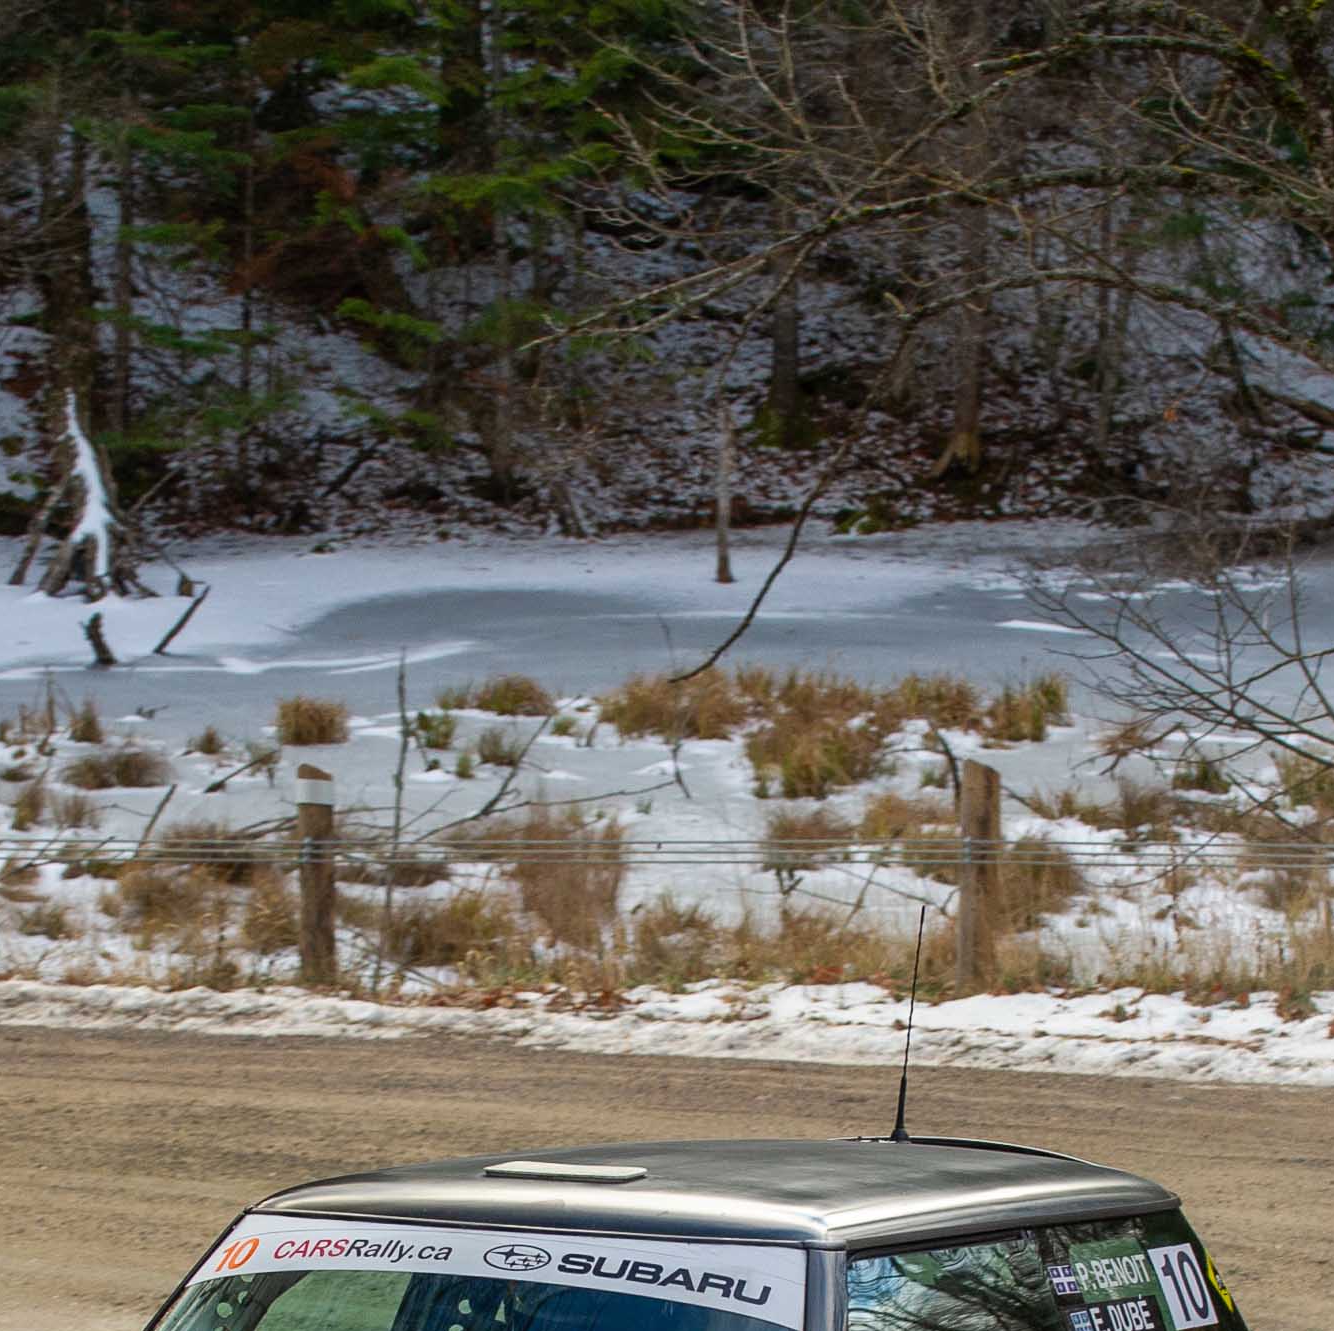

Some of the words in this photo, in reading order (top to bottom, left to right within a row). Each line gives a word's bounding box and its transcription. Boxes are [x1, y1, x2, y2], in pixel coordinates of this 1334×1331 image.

[215, 1238, 259, 1272] 10
[274, 1239, 453, 1263] CARSRally.ca
[557, 1253, 771, 1305] SUBARU
[1161, 1250, 1209, 1322] 10
